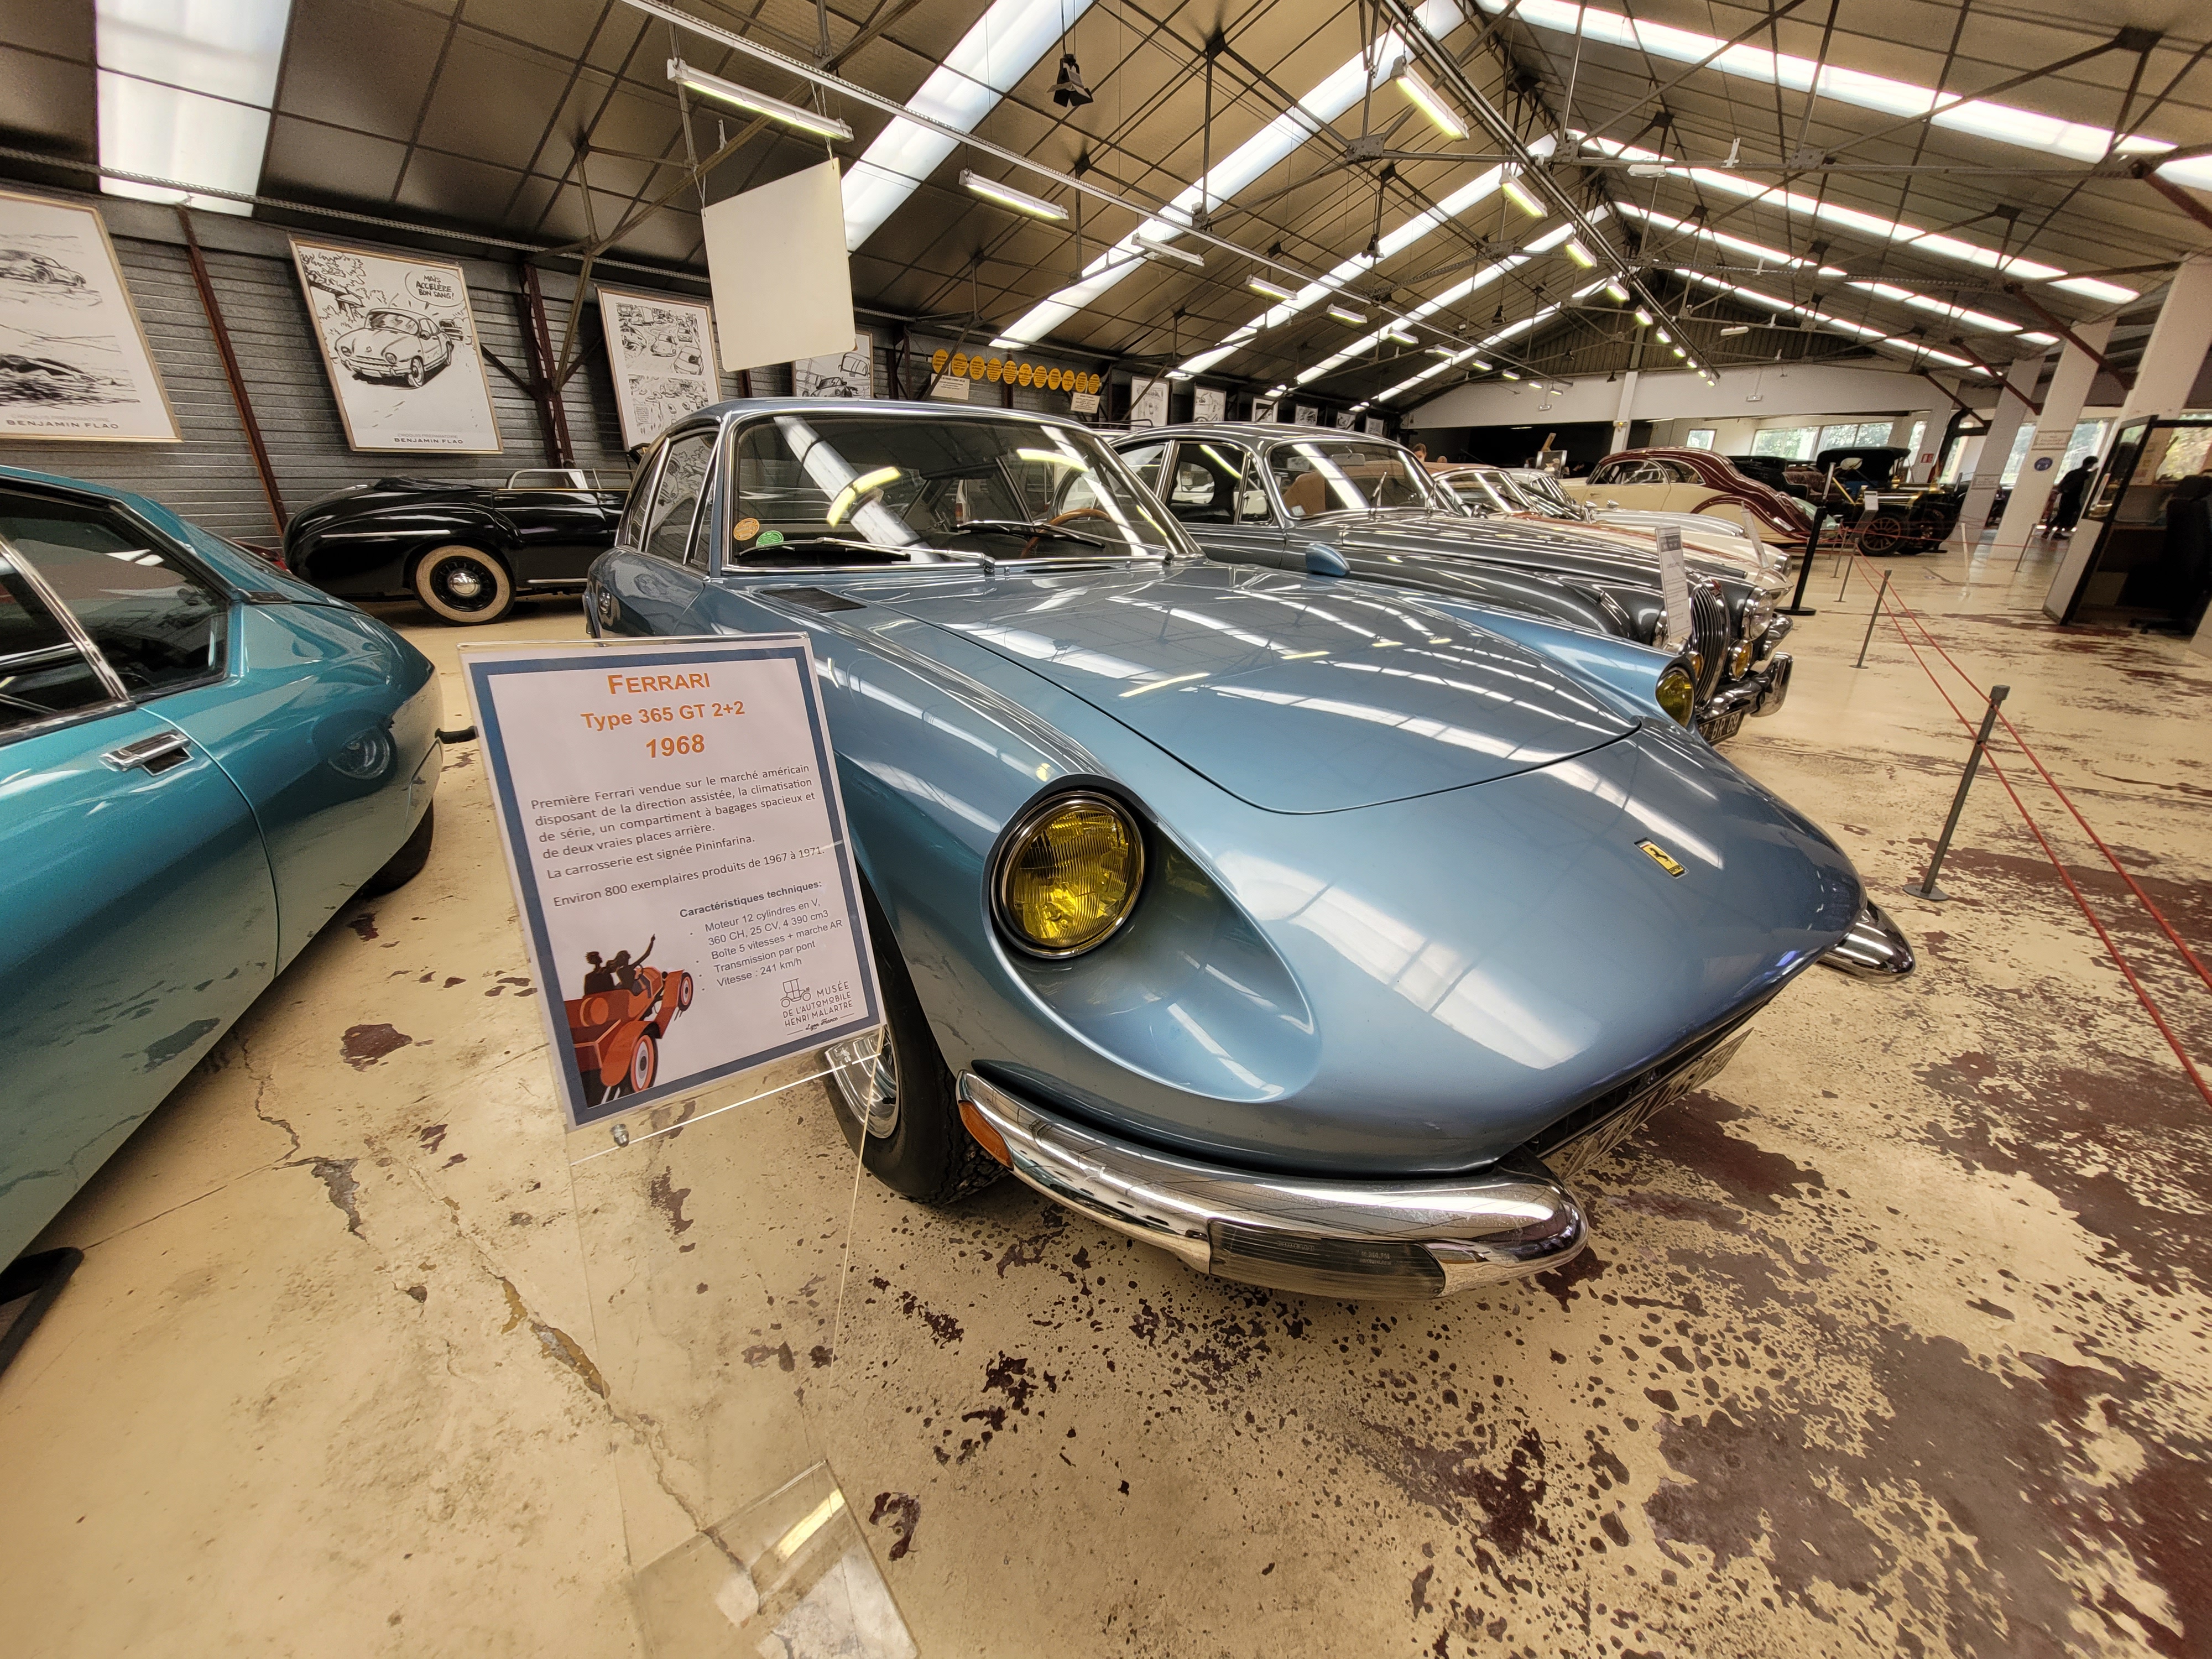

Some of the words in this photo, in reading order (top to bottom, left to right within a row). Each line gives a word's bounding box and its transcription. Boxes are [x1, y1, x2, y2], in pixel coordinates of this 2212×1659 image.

[6, 420, 80, 428] BENJAMIN
[607, 672, 711, 695] FERRARI
[581, 712, 633, 732] Type
[638, 707, 674, 724] 365
[679, 703, 706, 720] GT
[712, 701, 745, 717] 2+2
[1711, 718, 1725, 740] BR
[1726, 712, 1739, 733] 69
[645, 734, 705, 758] 1968
[531, 794, 590, 810] Première
[594, 787, 635, 801] Ferrari
[639, 782, 681, 795] vendue
[685, 779, 702, 789] sur
[706, 776, 716, 786] le
[720, 770, 759, 784] marché
[762, 764, 810, 779] américain
[535, 809, 597, 826] disposant
[601, 806, 617, 817] de
[620, 804, 632, 813] la
[635, 796, 686, 811] direction
[690, 790, 735, 804] assistée,
[738, 787, 748, 796] la
[751, 778, 812, 795] climatisation
[539, 832, 555, 843] de
[560, 827, 596, 839] série,
[599, 824, 615, 833] un
[620, 810, 702, 830] compartiment
[705, 807, 712, 817] à
[715, 802, 758, 815] bagages
[760, 794, 803, 809] spacieux
[805, 792, 816, 801] et
[542, 848, 559, 859] de
[562, 844, 594, 856] deux
[596, 837, 633, 850] vraies
[636, 831, 672, 846] places
[675, 824, 715, 837] arrière.
[547, 869, 562, 879] La
[565, 856, 633, 875] carrosserie
[637, 852, 654, 863] est
[656, 845, 693, 859] signée
[696, 836, 755, 852] Pininfarina.
[554, 890, 602, 907] Environ
[604, 884, 628, 896] 800
[631, 872, 699, 891] exemplaires
[702, 863, 745, 879] produits
[748, 859, 761, 868] de
[763, 853, 787, 865] 1967
[790, 851, 796, 860] à
[799, 846, 825, 859] 1971.
[680, 893, 765, 918] Caractéristiques
[767, 881, 822, 898] techniques:
[705, 917, 739, 932] Moteur
[743, 914, 754, 924] 12
[757, 905, 796, 922] cylindres
[798, 902, 810, 910] en
[811, 898, 821, 907] V,
[708, 935, 726, 946] 360
[729, 930, 748, 941] CH,
[750, 926, 762, 936] 25
[764, 921, 781, 932] CV,
[782, 919, 789, 927] 4
[791, 915, 808, 925] 390
[810, 910, 829, 921] cm3
[711, 946, 737, 960] Boîte
[739, 943, 745, 953] 5
[747, 935, 785, 950] vitesses
[796, 924, 828, 938] marche
[830, 919, 843, 930] AR
[713, 952, 776, 973] Transmission
[778, 947, 794, 958] par
[795, 940, 816, 954] pont
[717, 971, 753, 987] Vitesse
[759, 964, 776, 976] 241
[780, 958, 802, 971] km/h
[782, 1009, 794, 1018] DE
[796, 991, 851, 1014] L'AUTOMOBILE
[816, 980, 849, 998] MUSÉE
[784, 1013, 810, 1027] HENRI
[811, 1000, 853, 1019] MALARTRE
[805, 1023, 820, 1031] Lyon
[821, 1017, 838, 1026] France
